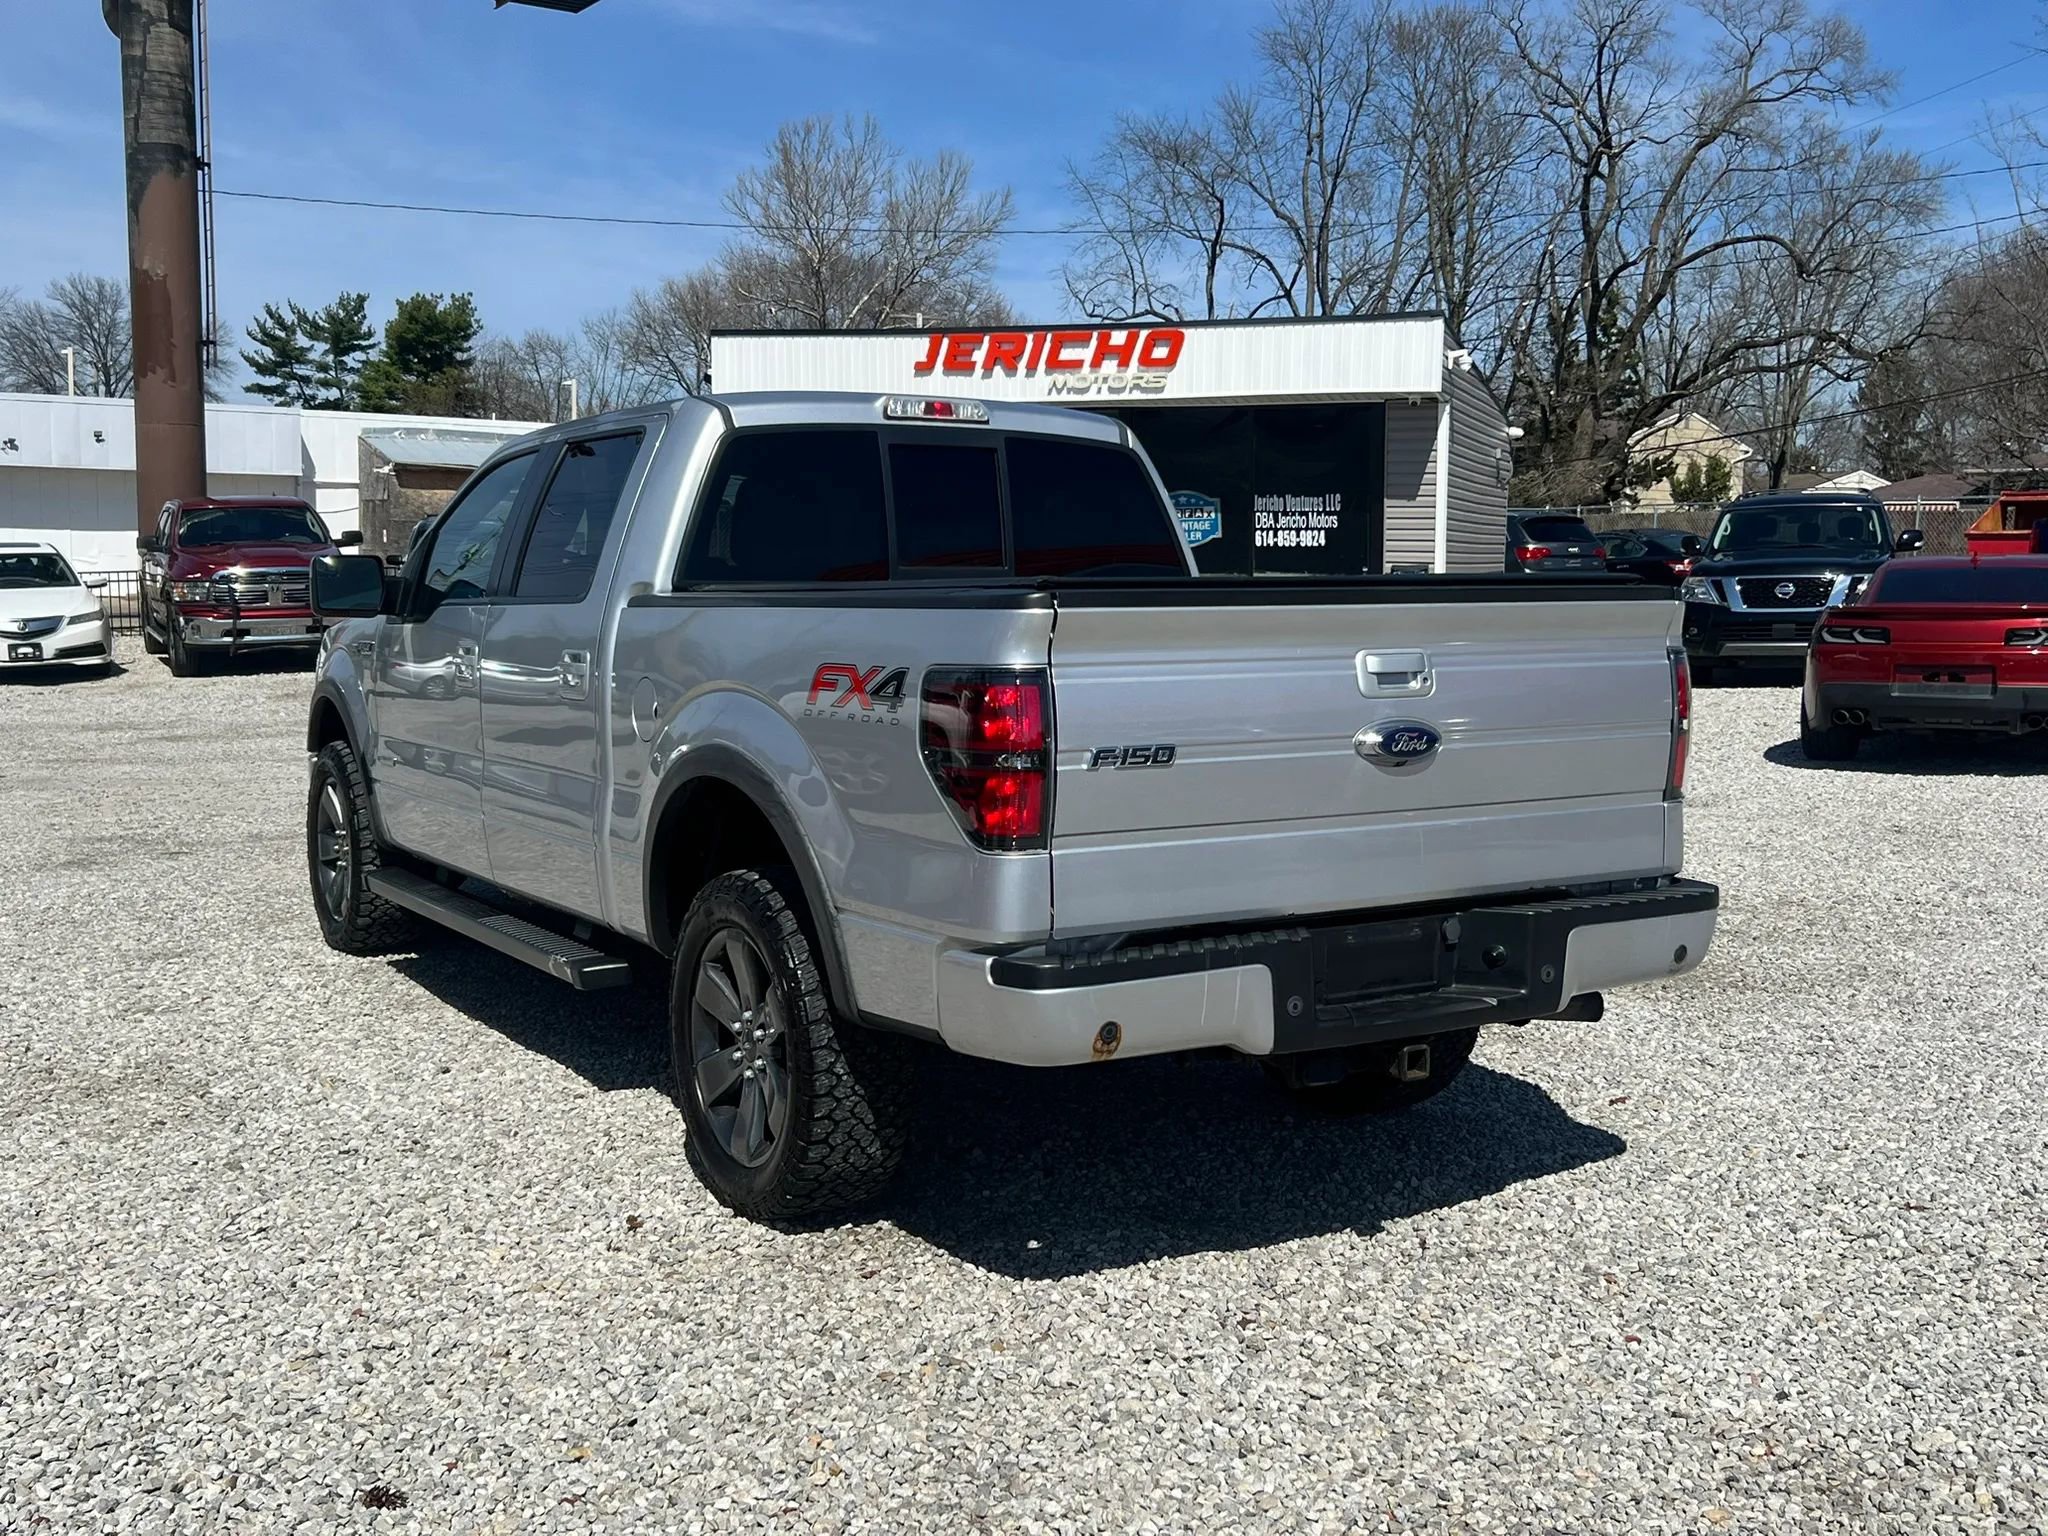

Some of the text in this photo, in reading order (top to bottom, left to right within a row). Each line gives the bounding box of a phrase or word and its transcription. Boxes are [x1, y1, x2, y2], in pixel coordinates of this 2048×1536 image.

[914, 328, 1185, 372] JERICHO
[1048, 372, 1169, 394] MOTORS
[1254, 493, 1341, 512] Jericho Ventures LLC
[1176, 508, 1215, 518] RFAX
[1255, 512, 1338, 528] DBA Jericho Motors
[1181, 520, 1211, 530] NTAGE
[1255, 529, 1326, 547] 614-859-9824
[806, 662, 910, 713] FX4
[803, 708, 901, 726] OFF ROAD
[1391, 731, 1428, 752] Ford
